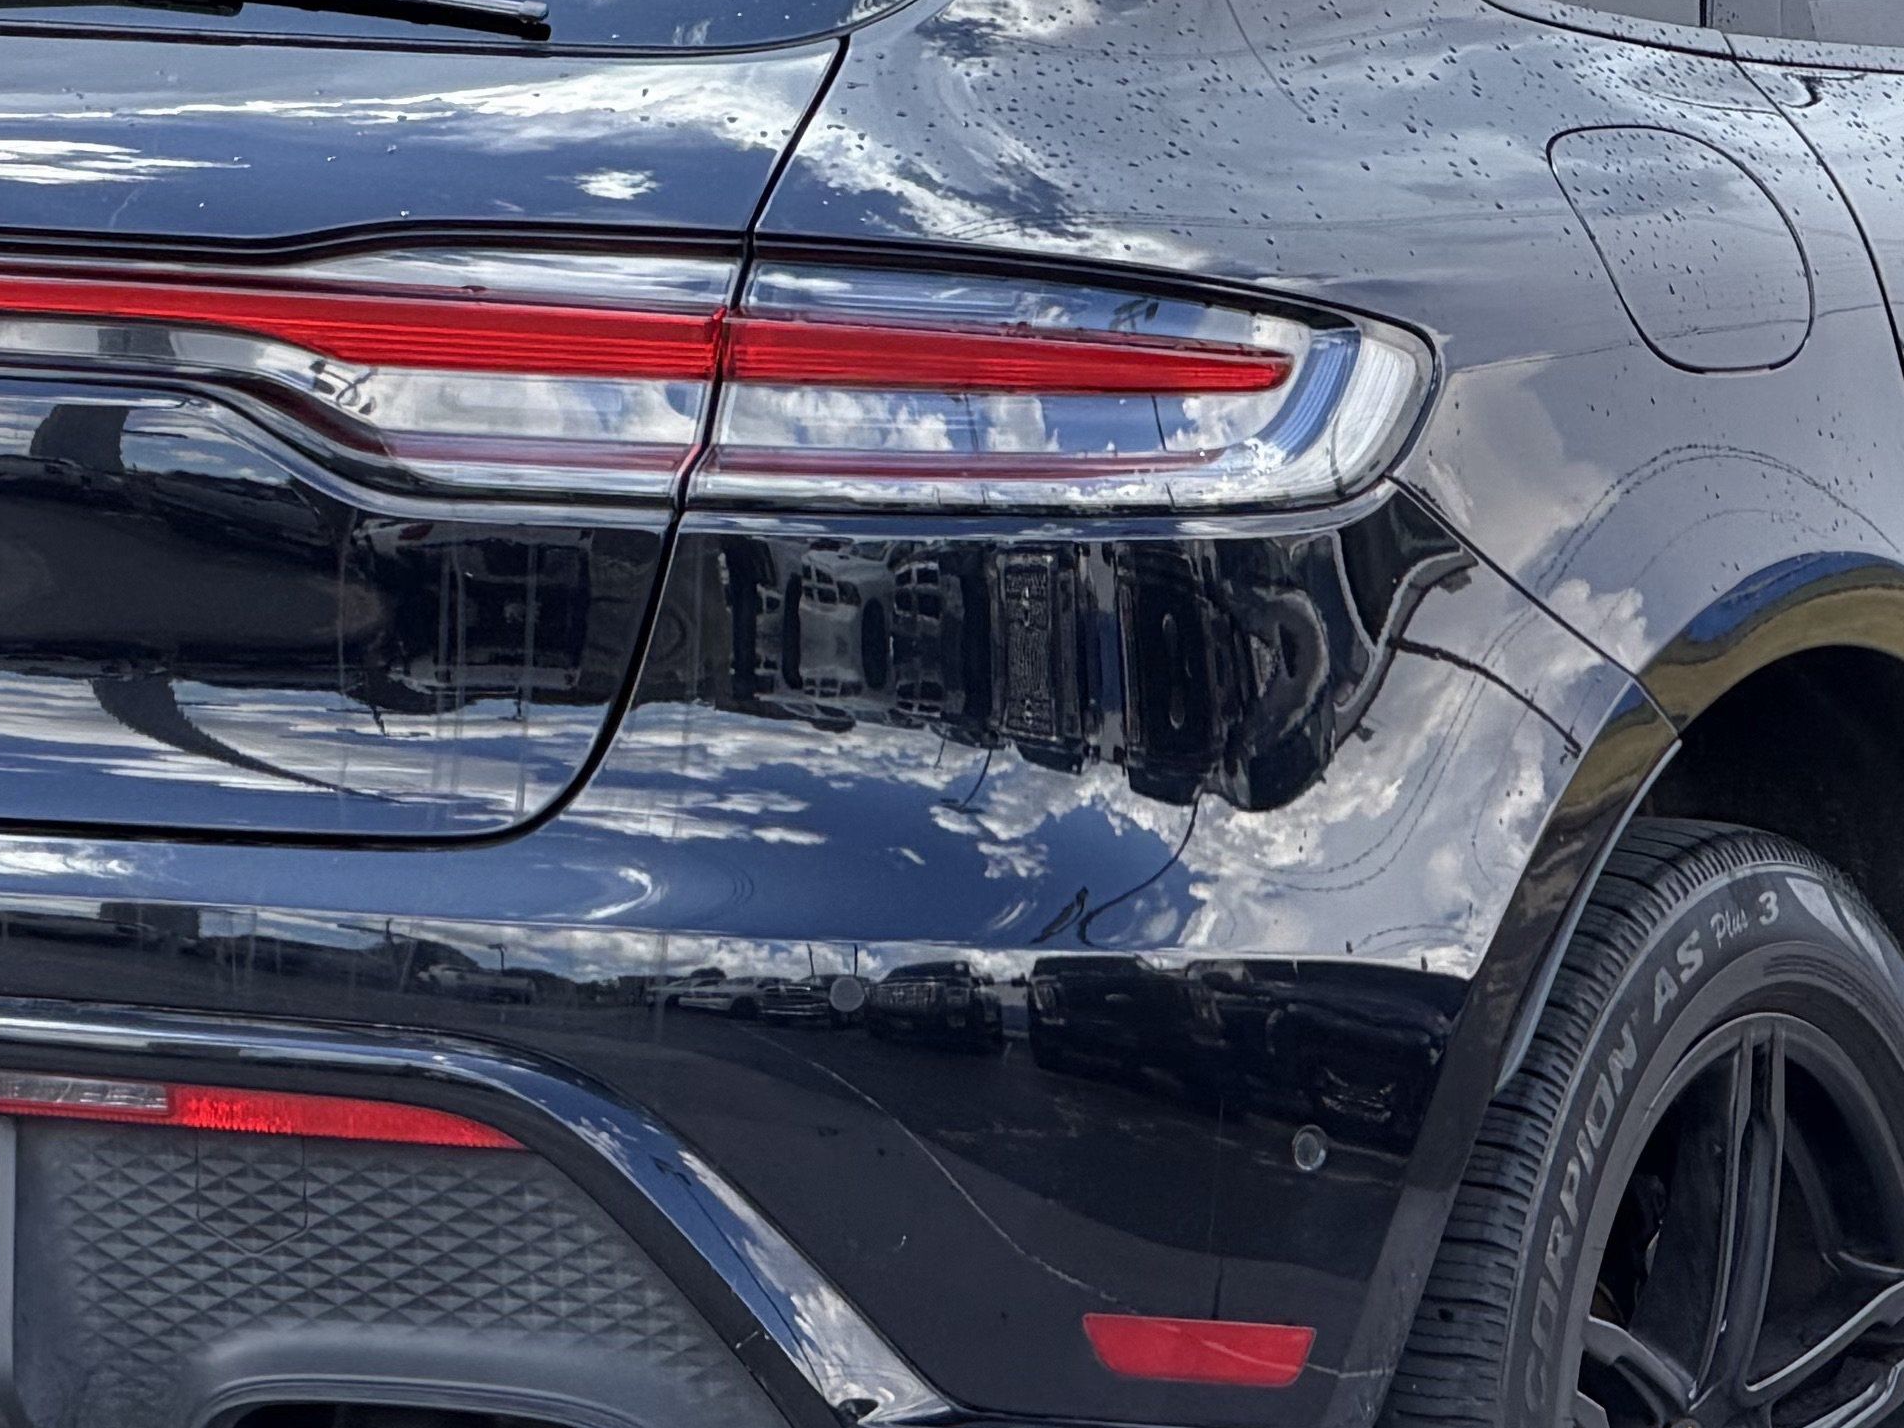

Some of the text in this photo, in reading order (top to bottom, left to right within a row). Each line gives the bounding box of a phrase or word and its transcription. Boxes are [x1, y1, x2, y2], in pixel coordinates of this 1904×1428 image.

[1654, 929, 1704, 1023] AS
[1710, 908, 1749, 949] Plus
[1758, 890, 1780, 925] 3
